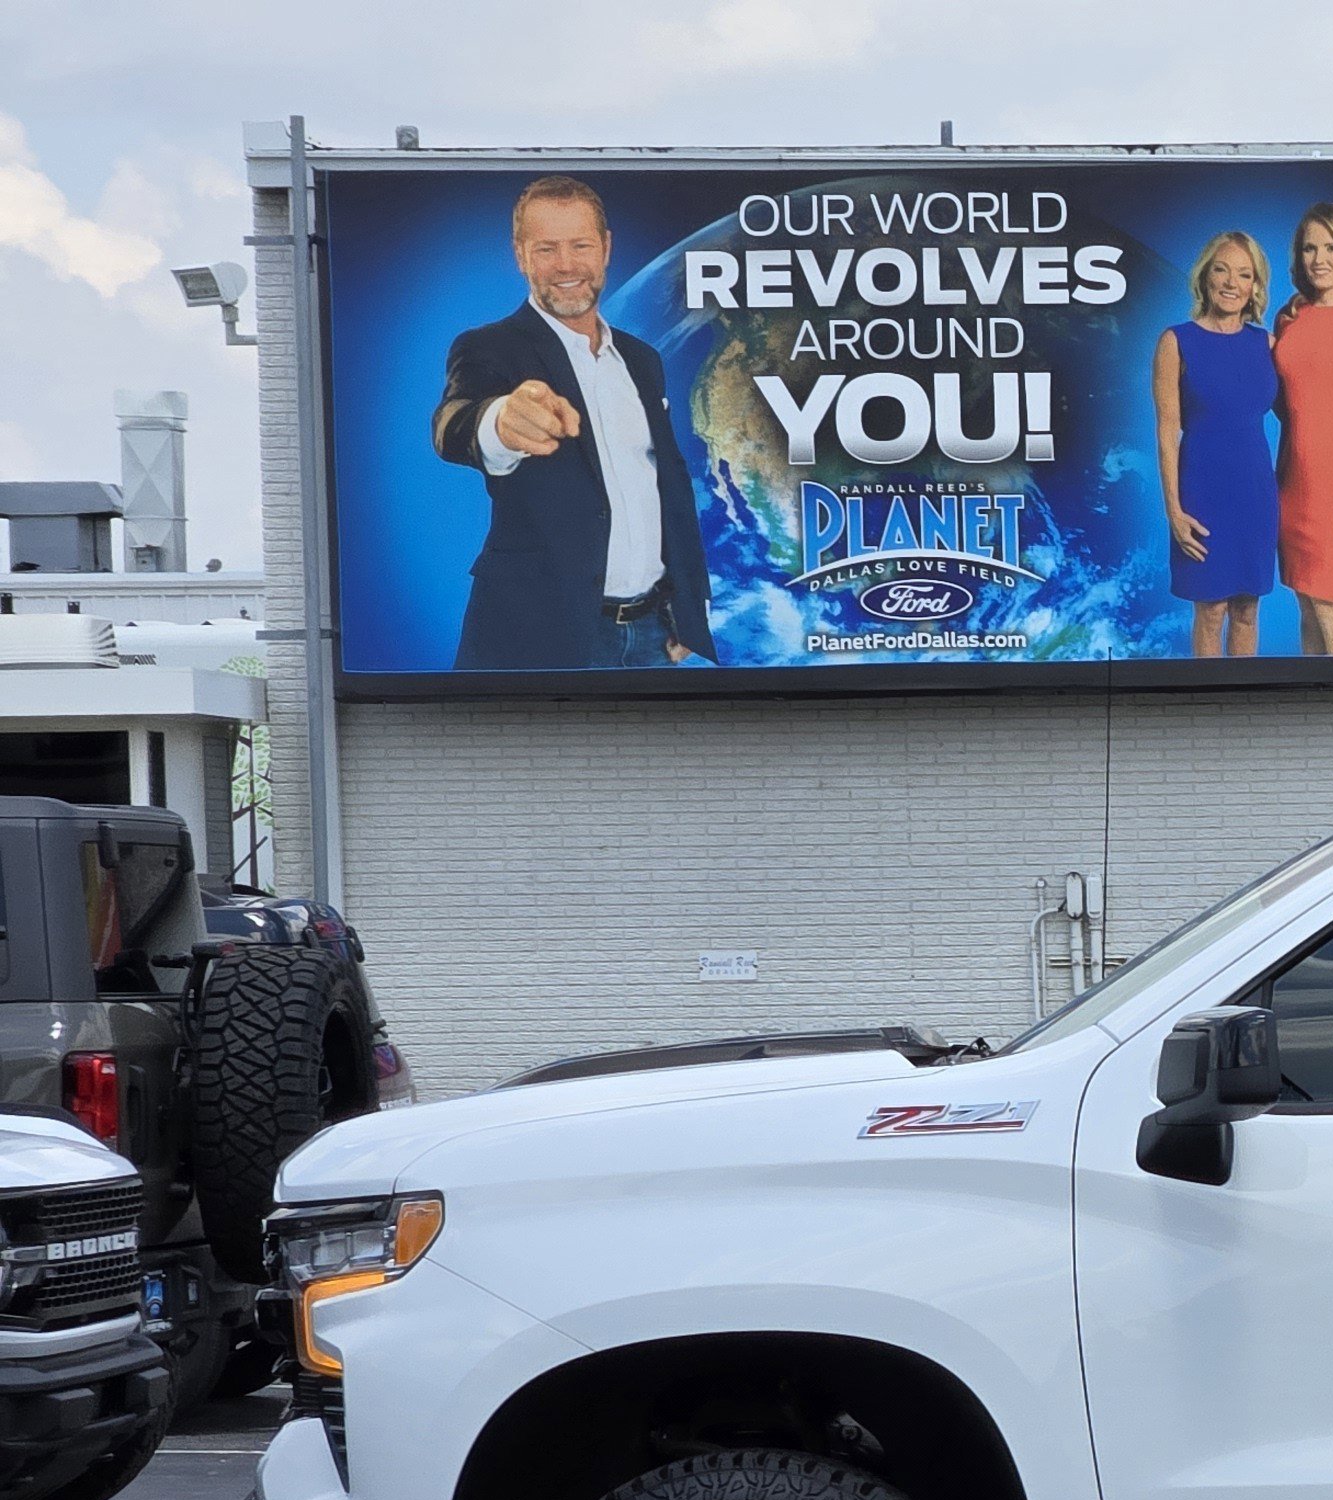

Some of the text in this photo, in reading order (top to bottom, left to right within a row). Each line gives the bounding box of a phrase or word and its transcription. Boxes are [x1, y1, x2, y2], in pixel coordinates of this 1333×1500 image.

[739, 192, 1067, 236] OUR WORLD
[685, 245, 1127, 309] REVOLVES
[790, 317, 1024, 361] AROUND
[753, 372, 1055, 466] YOU!
[840, 483, 985, 494] RANDALL REED'S
[801, 481, 1025, 574] PLANET
[809, 560, 1016, 592] DALLAS LOVE FIELD
[881, 584, 951, 614] Ford
[807, 631, 1028, 652] PlanetFordDallas.com
[857, 1100, 1041, 1139] Z71
